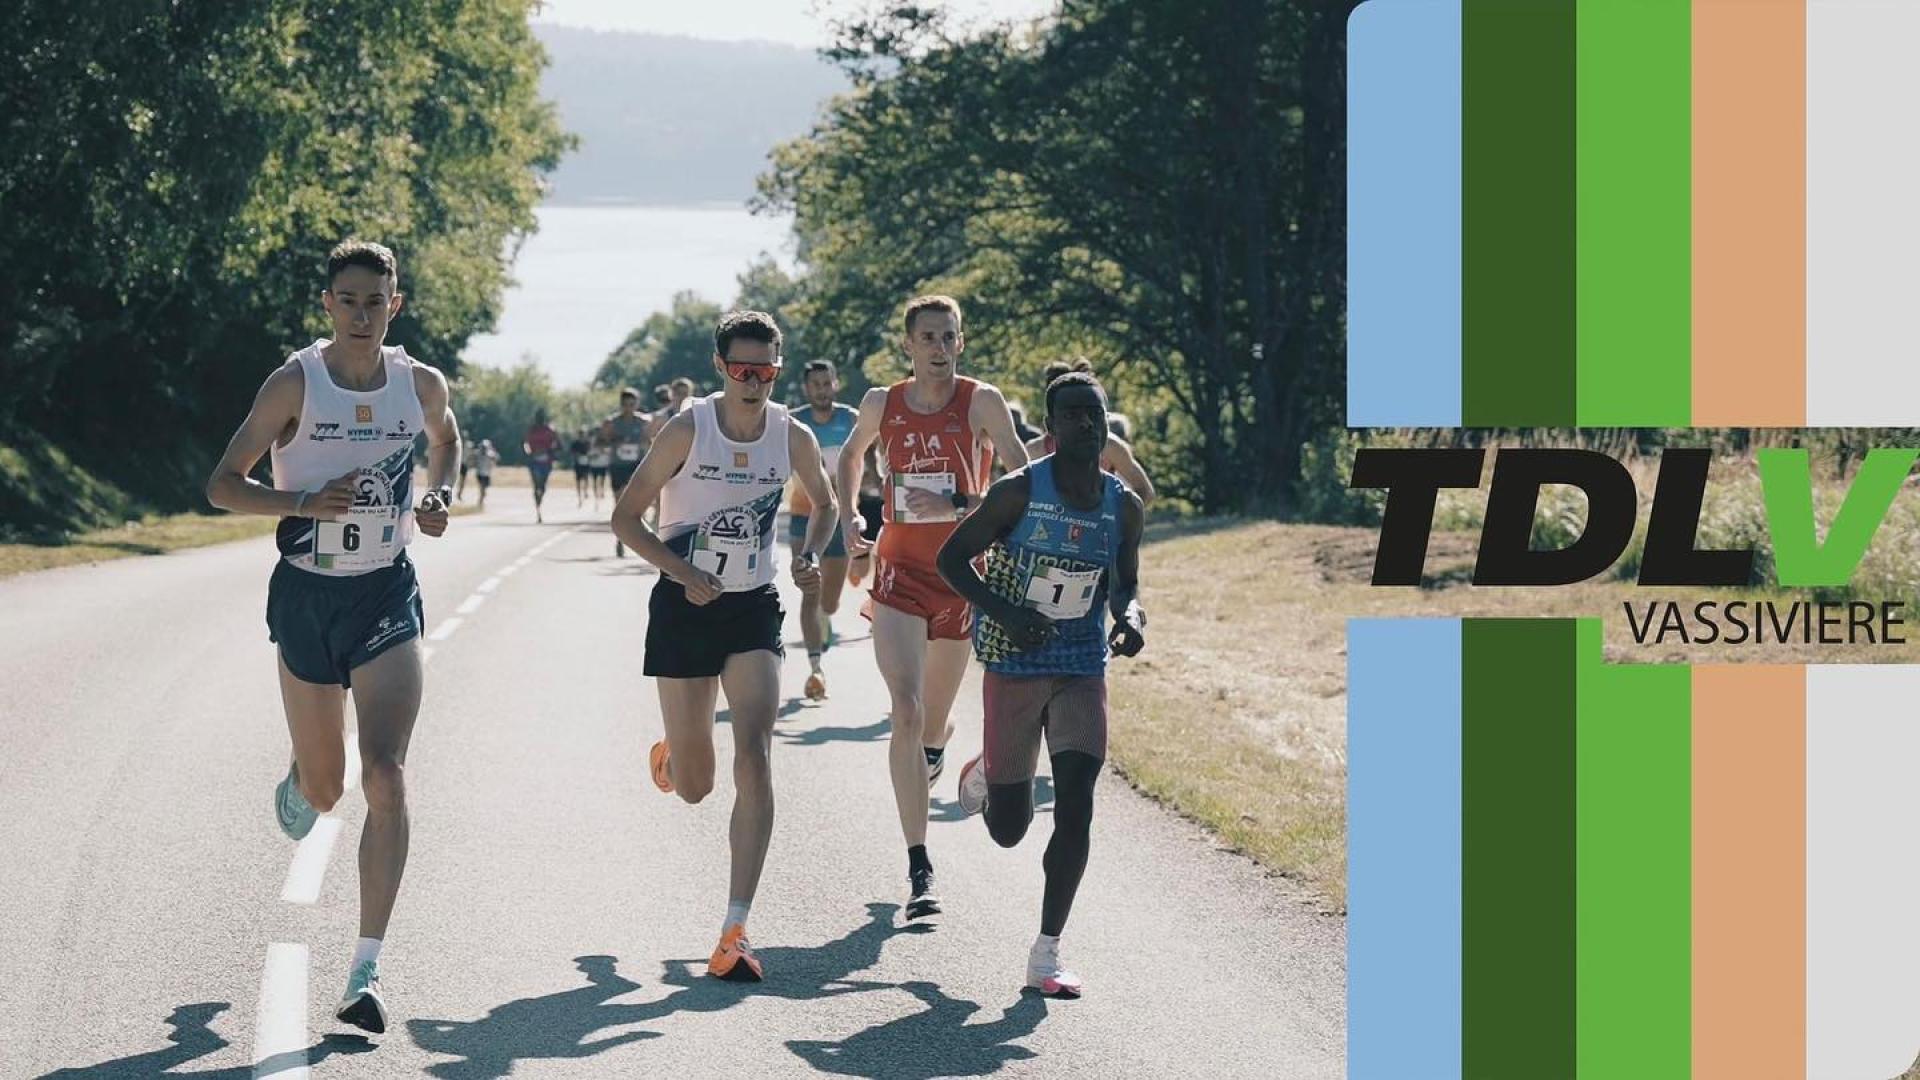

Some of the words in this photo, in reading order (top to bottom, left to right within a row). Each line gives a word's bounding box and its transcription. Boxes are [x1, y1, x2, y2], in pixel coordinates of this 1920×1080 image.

[1029, 501, 1054, 512] SUPER
[342, 523, 360, 552] 6
[715, 551, 729, 576] 7
[1052, 583, 1065, 605] 1
